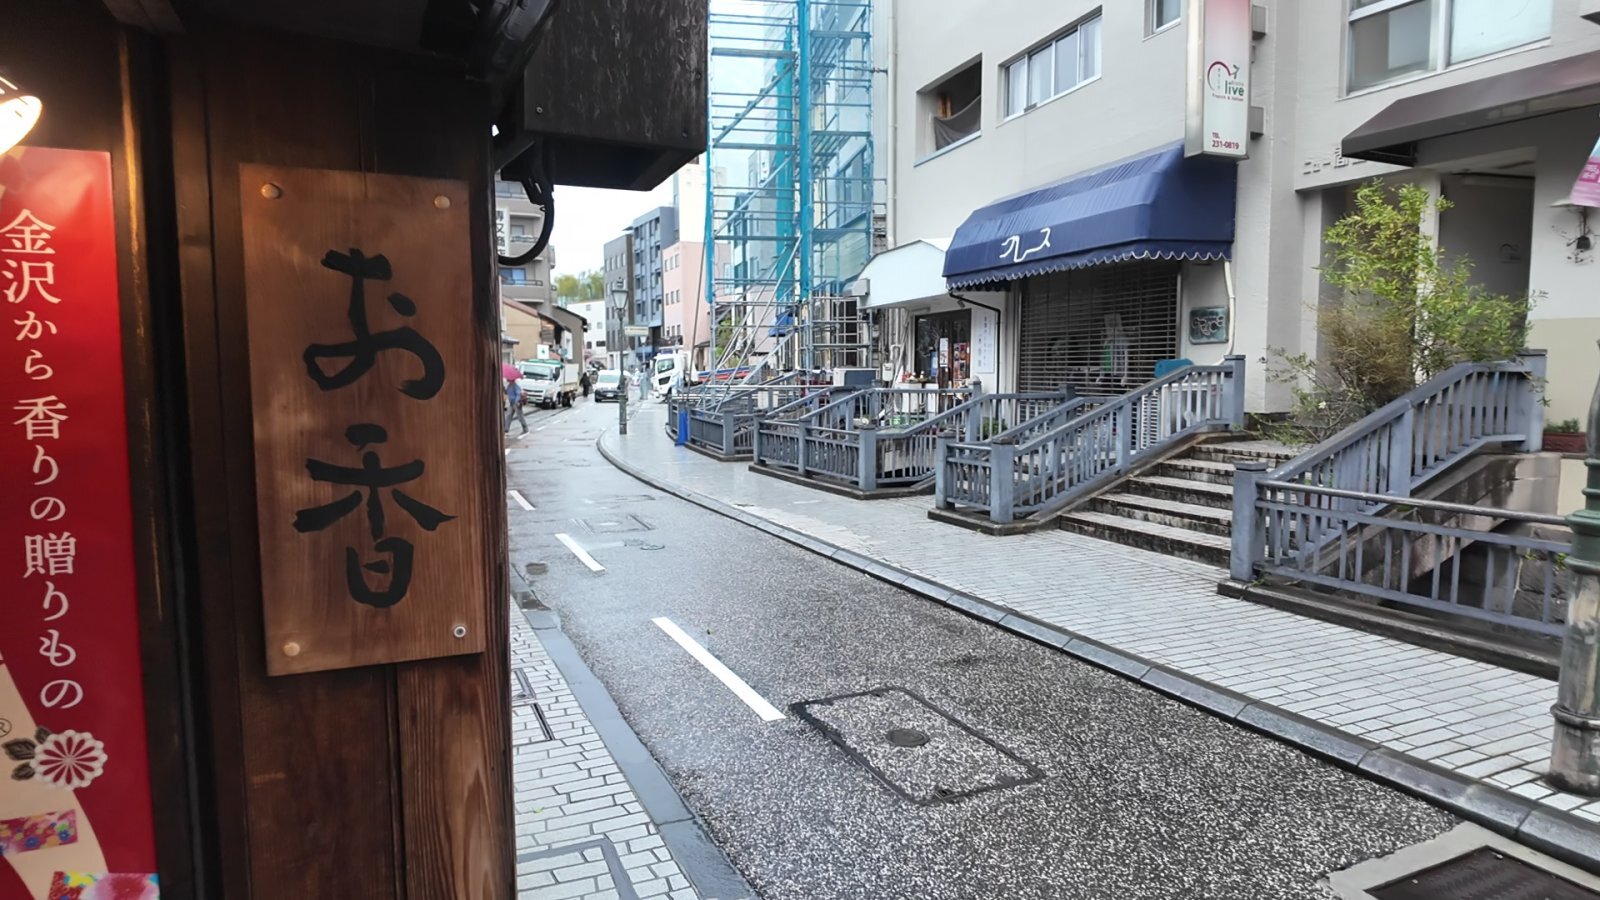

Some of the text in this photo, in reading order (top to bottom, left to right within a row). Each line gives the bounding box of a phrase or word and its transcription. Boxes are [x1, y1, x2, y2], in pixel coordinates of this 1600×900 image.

[1212, 140, 1239, 150] 231-0819
[0, 208, 84, 709] 金沢から香りの贈りもの
[293, 247, 458, 609] お香
